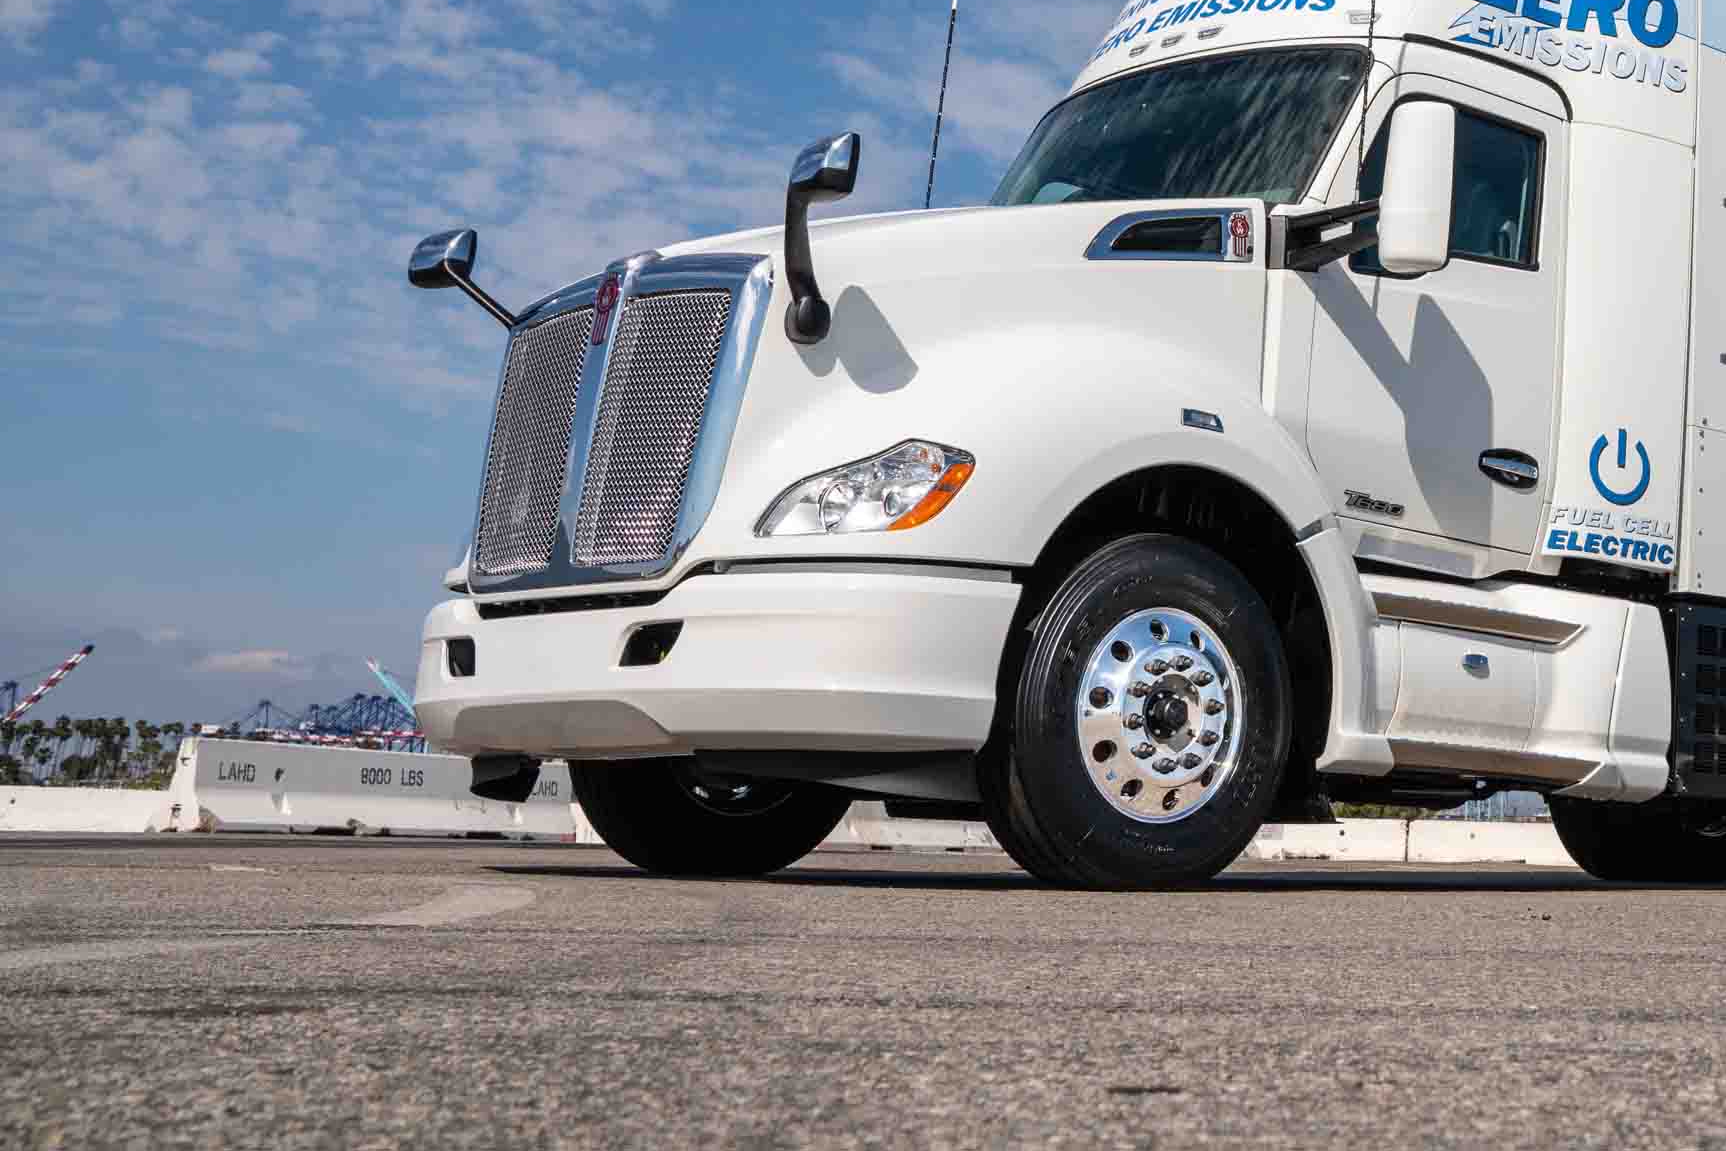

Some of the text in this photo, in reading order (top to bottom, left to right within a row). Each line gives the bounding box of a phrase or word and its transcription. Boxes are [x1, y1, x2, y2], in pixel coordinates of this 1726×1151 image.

[1090, 18, 1146, 61] ERO
[1470, 14, 1688, 94] EMISSIONS
[1551, 507, 1674, 540] FUEL CELL
[1546, 529, 1674, 565] ELECTRIC
[217, 760, 256, 783] LAHD
[401, 767, 424, 787] LBS
